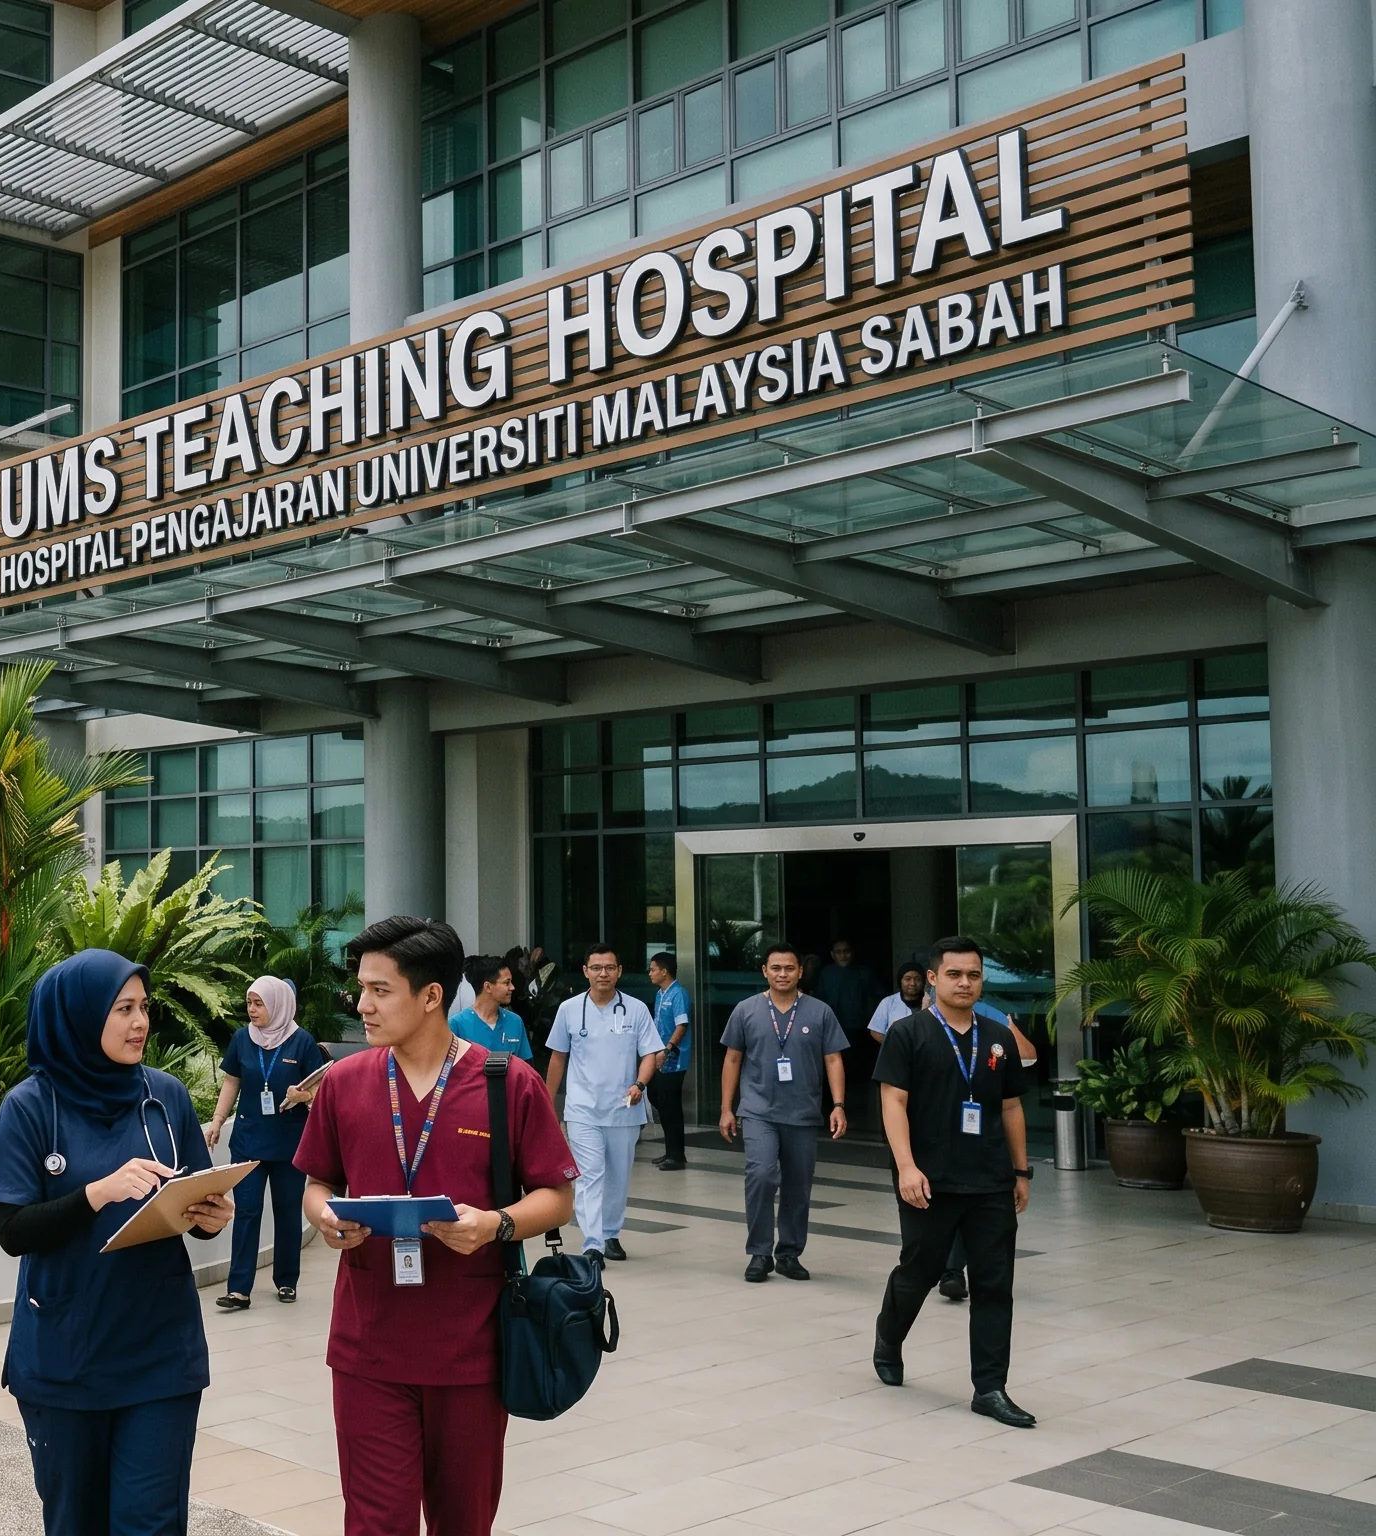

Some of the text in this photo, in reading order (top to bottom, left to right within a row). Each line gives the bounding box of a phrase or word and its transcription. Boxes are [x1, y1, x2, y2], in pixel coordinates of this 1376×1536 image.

[0, 127, 1070, 539] UMS TEACHING HOSPITAL
[0, 527, 124, 594] HOSPITAL
[130, 465, 349, 564] PENGAJARAN
[355, 400, 583, 507] UNIVERSITI
[592, 332, 849, 449] MALAYSIA
[860, 263, 1069, 378] SABAH
